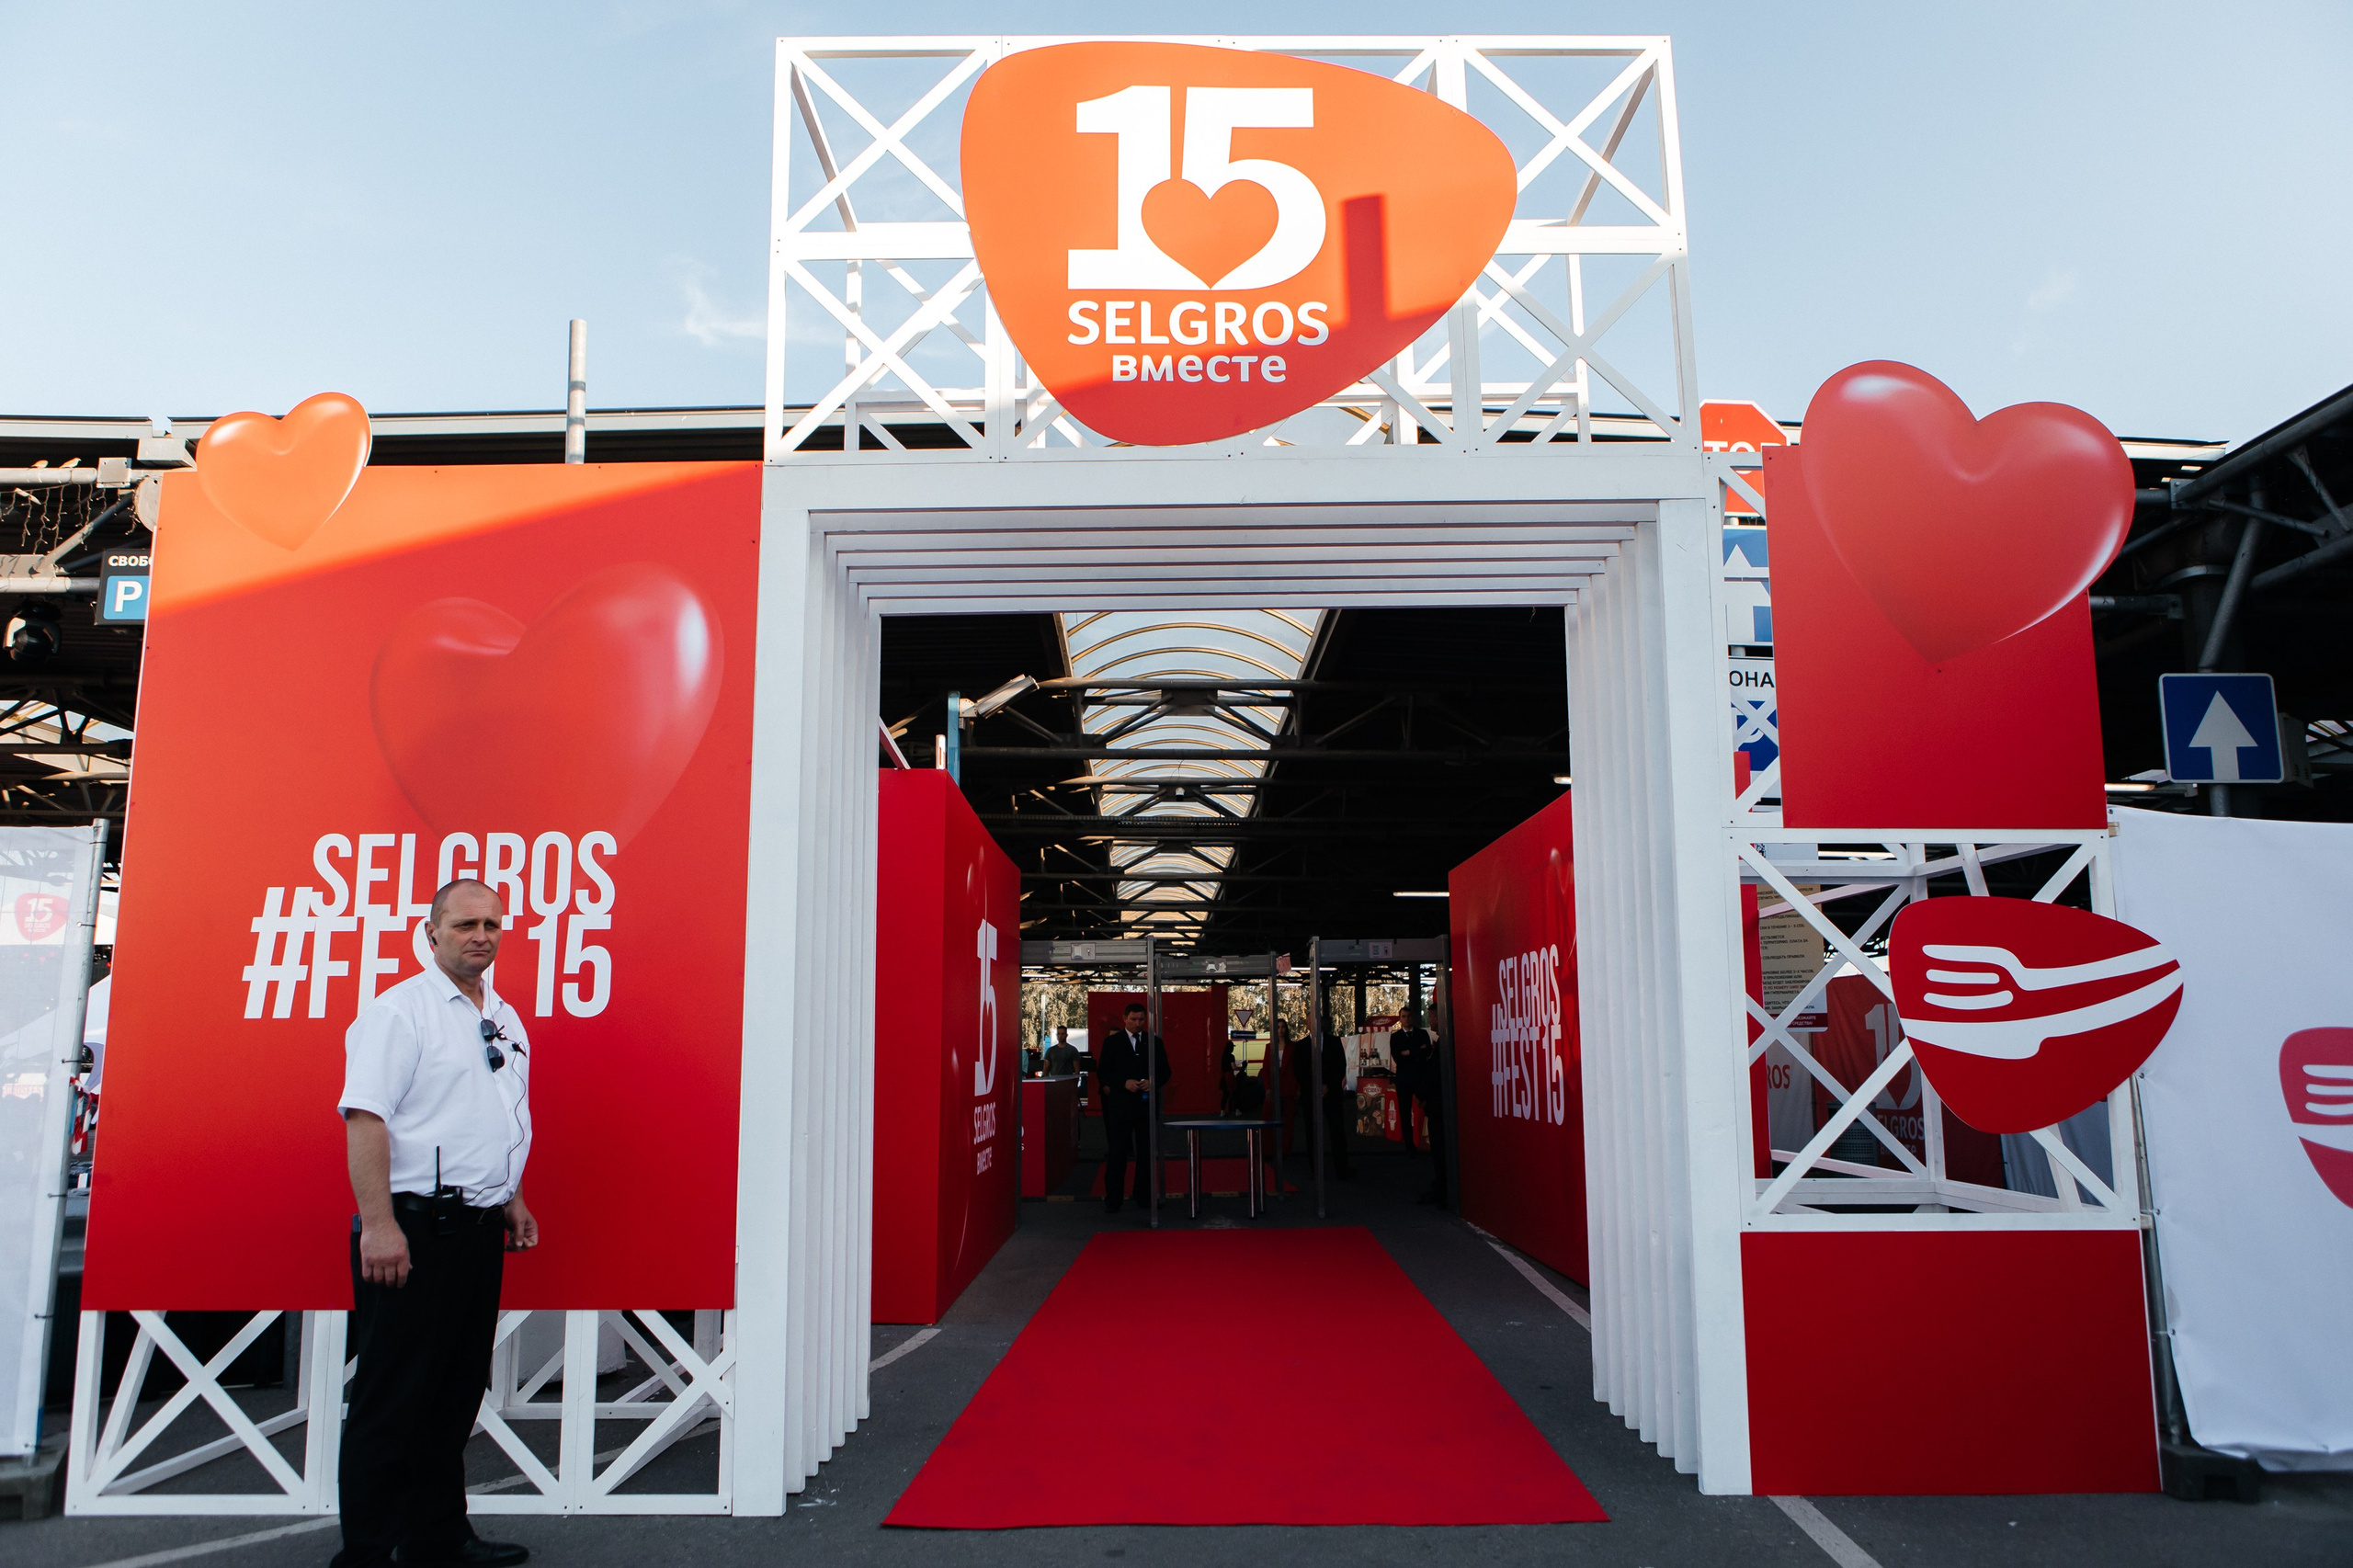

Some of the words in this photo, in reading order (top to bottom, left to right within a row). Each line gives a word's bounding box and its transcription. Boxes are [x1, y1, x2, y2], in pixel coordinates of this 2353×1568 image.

[1068, 85, 1326, 290] 15
[1068, 300, 1330, 346] SELGROS
[108, 555, 152, 566] СВОБ
[114, 580, 142, 612] P
[1729, 670, 1775, 688] ОНА
[310, 831, 618, 918] SELGROS
[24, 897, 53, 923] 15
[528, 914, 612, 1018] 15
[1499, 943, 1561, 1028] SELGROS
[974, 918, 997, 1096] 15
[1491, 1003, 1540, 1121] #FEST
[1542, 1025, 1564, 1126] 15
[974, 1101, 995, 1145] SELGROS
